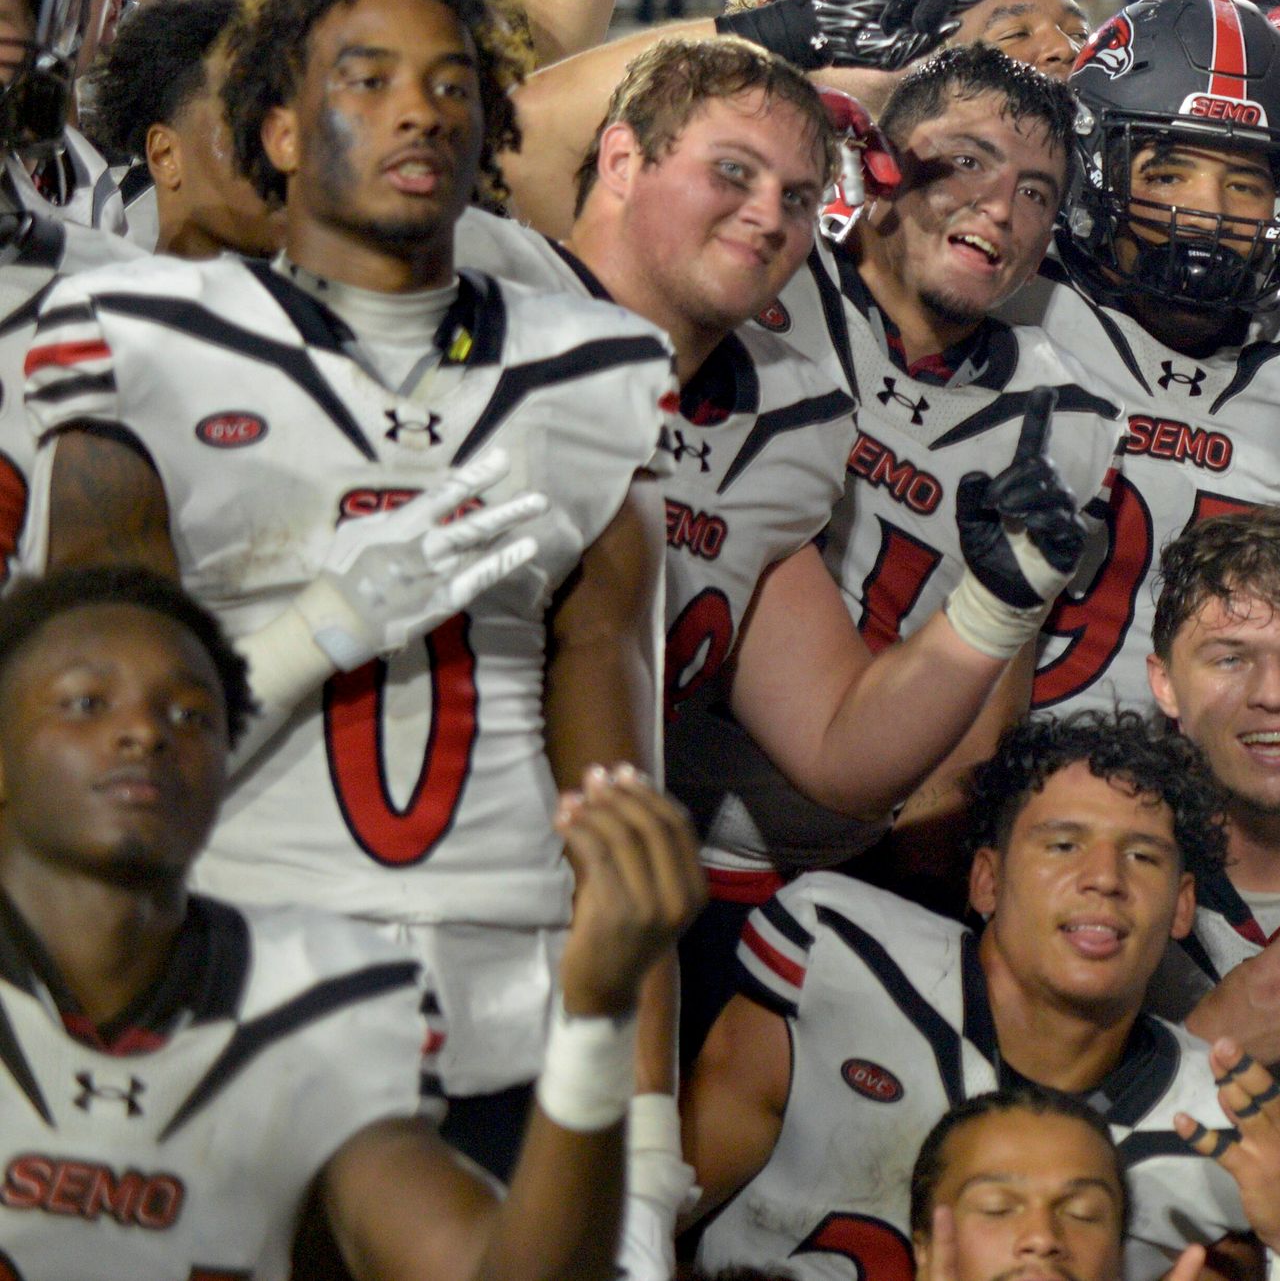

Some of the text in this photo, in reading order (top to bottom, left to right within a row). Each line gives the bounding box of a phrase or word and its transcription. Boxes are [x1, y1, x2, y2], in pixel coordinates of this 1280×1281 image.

[1191, 96, 1262, 125] SEMO
[848, 433, 944, 516] EMO
[1126, 414, 1233, 473] SEMO
[665, 497, 728, 561] EMO
[1, 1152, 185, 1230] SEMO
